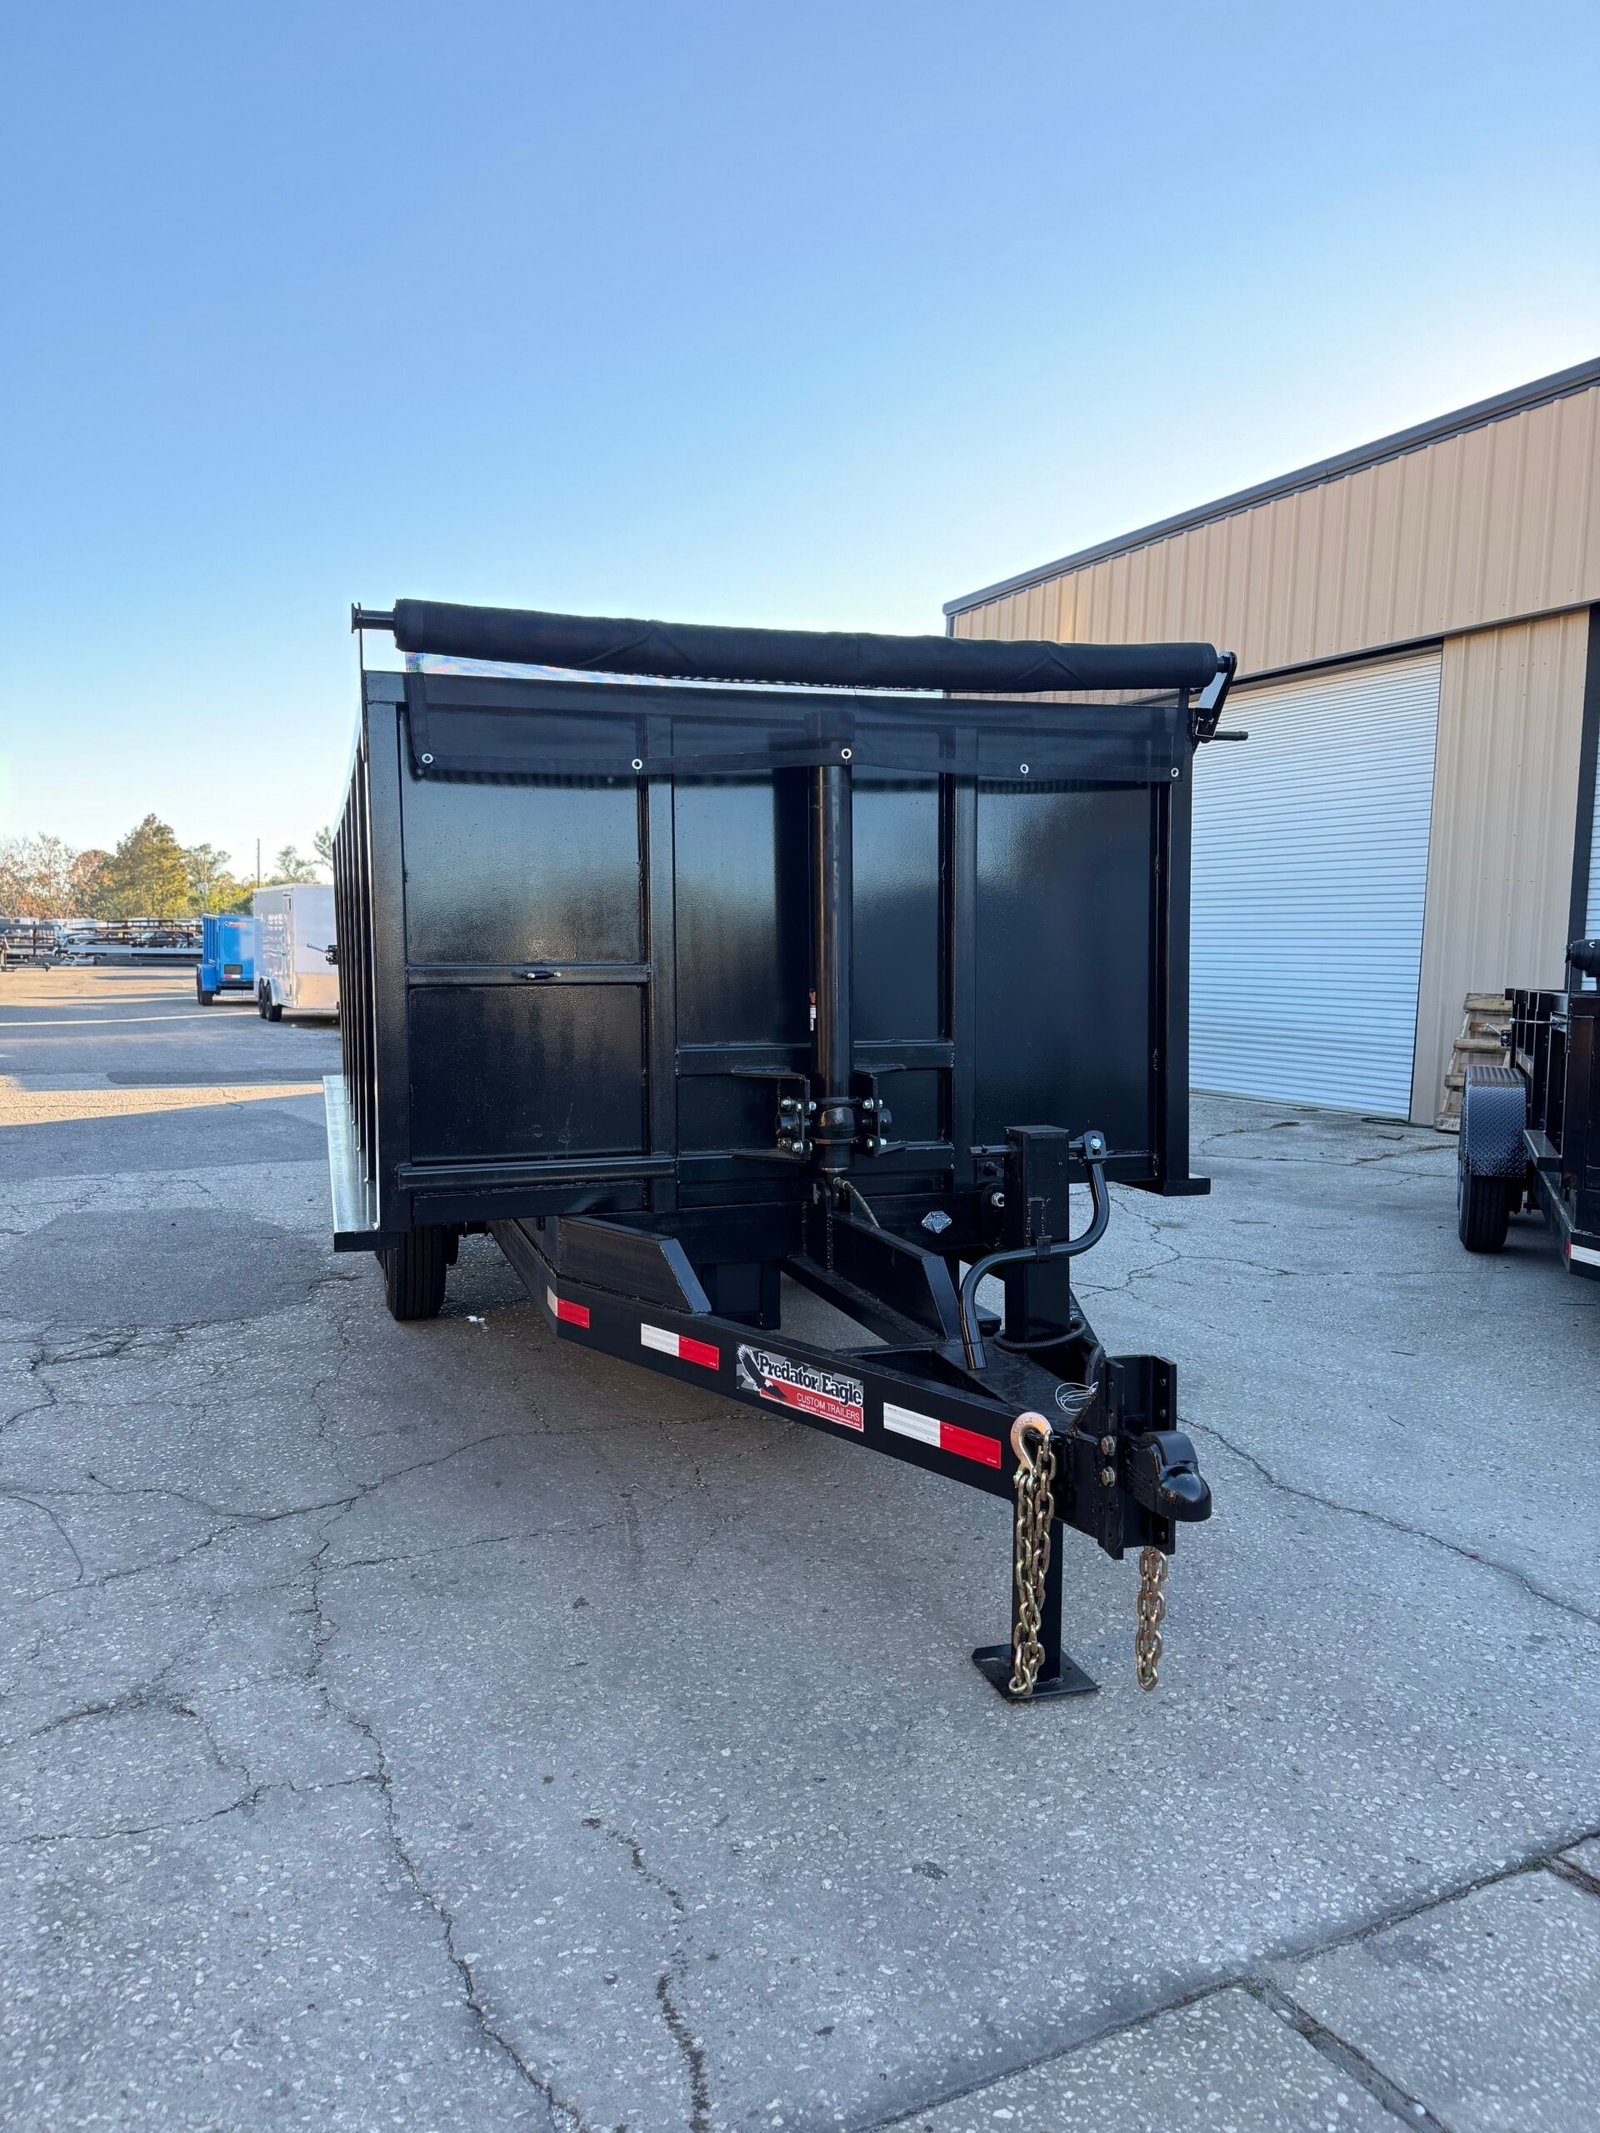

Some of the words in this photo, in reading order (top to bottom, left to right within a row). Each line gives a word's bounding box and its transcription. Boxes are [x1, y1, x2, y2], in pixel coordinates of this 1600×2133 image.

[758, 1353, 819, 1391] Predator
[820, 1373, 863, 1406] Eagle
[796, 1392, 826, 1410] CUSTOM
[827, 1402, 860, 1422] TRAILERS
